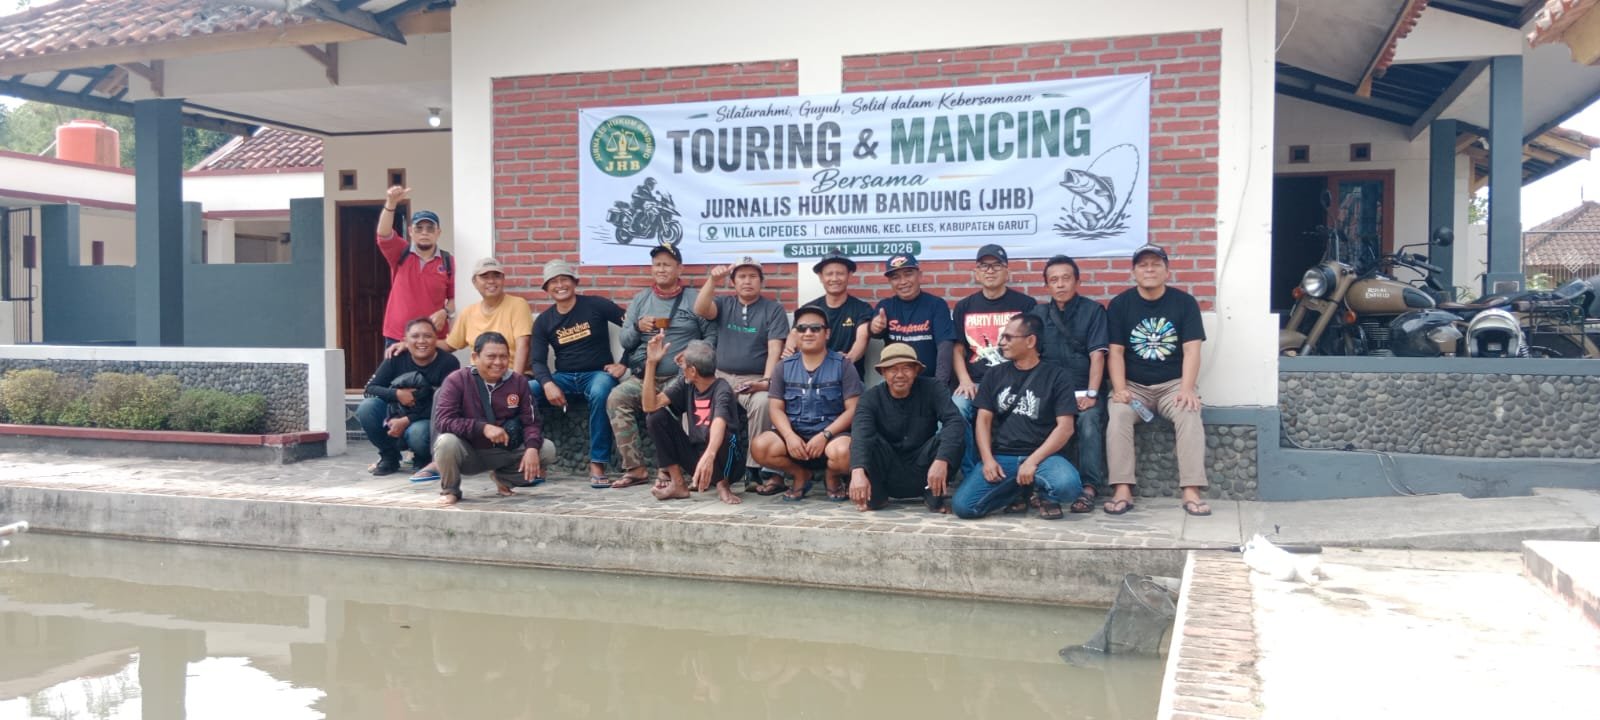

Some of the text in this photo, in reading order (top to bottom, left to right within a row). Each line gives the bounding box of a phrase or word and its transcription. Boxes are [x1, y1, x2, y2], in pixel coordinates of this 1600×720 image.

[715, 92, 1034, 122] Silaturahmi, Guyub, Solid dalam Kebersamaan
[666, 107, 1091, 174] TOURING & MANCING
[810, 167, 929, 193] Bersama
[700, 186, 1035, 219] JURNALIS HUKUM BANDUNG (JHB)
[723, 219, 1030, 238] VILLA CIPEDES CANGKUANG, KEC. LELES, KABUPATEN GARUT
[852, 243, 879, 255] JULI
[883, 242, 914, 254] 2026
[967, 314, 991, 327] PARTY
